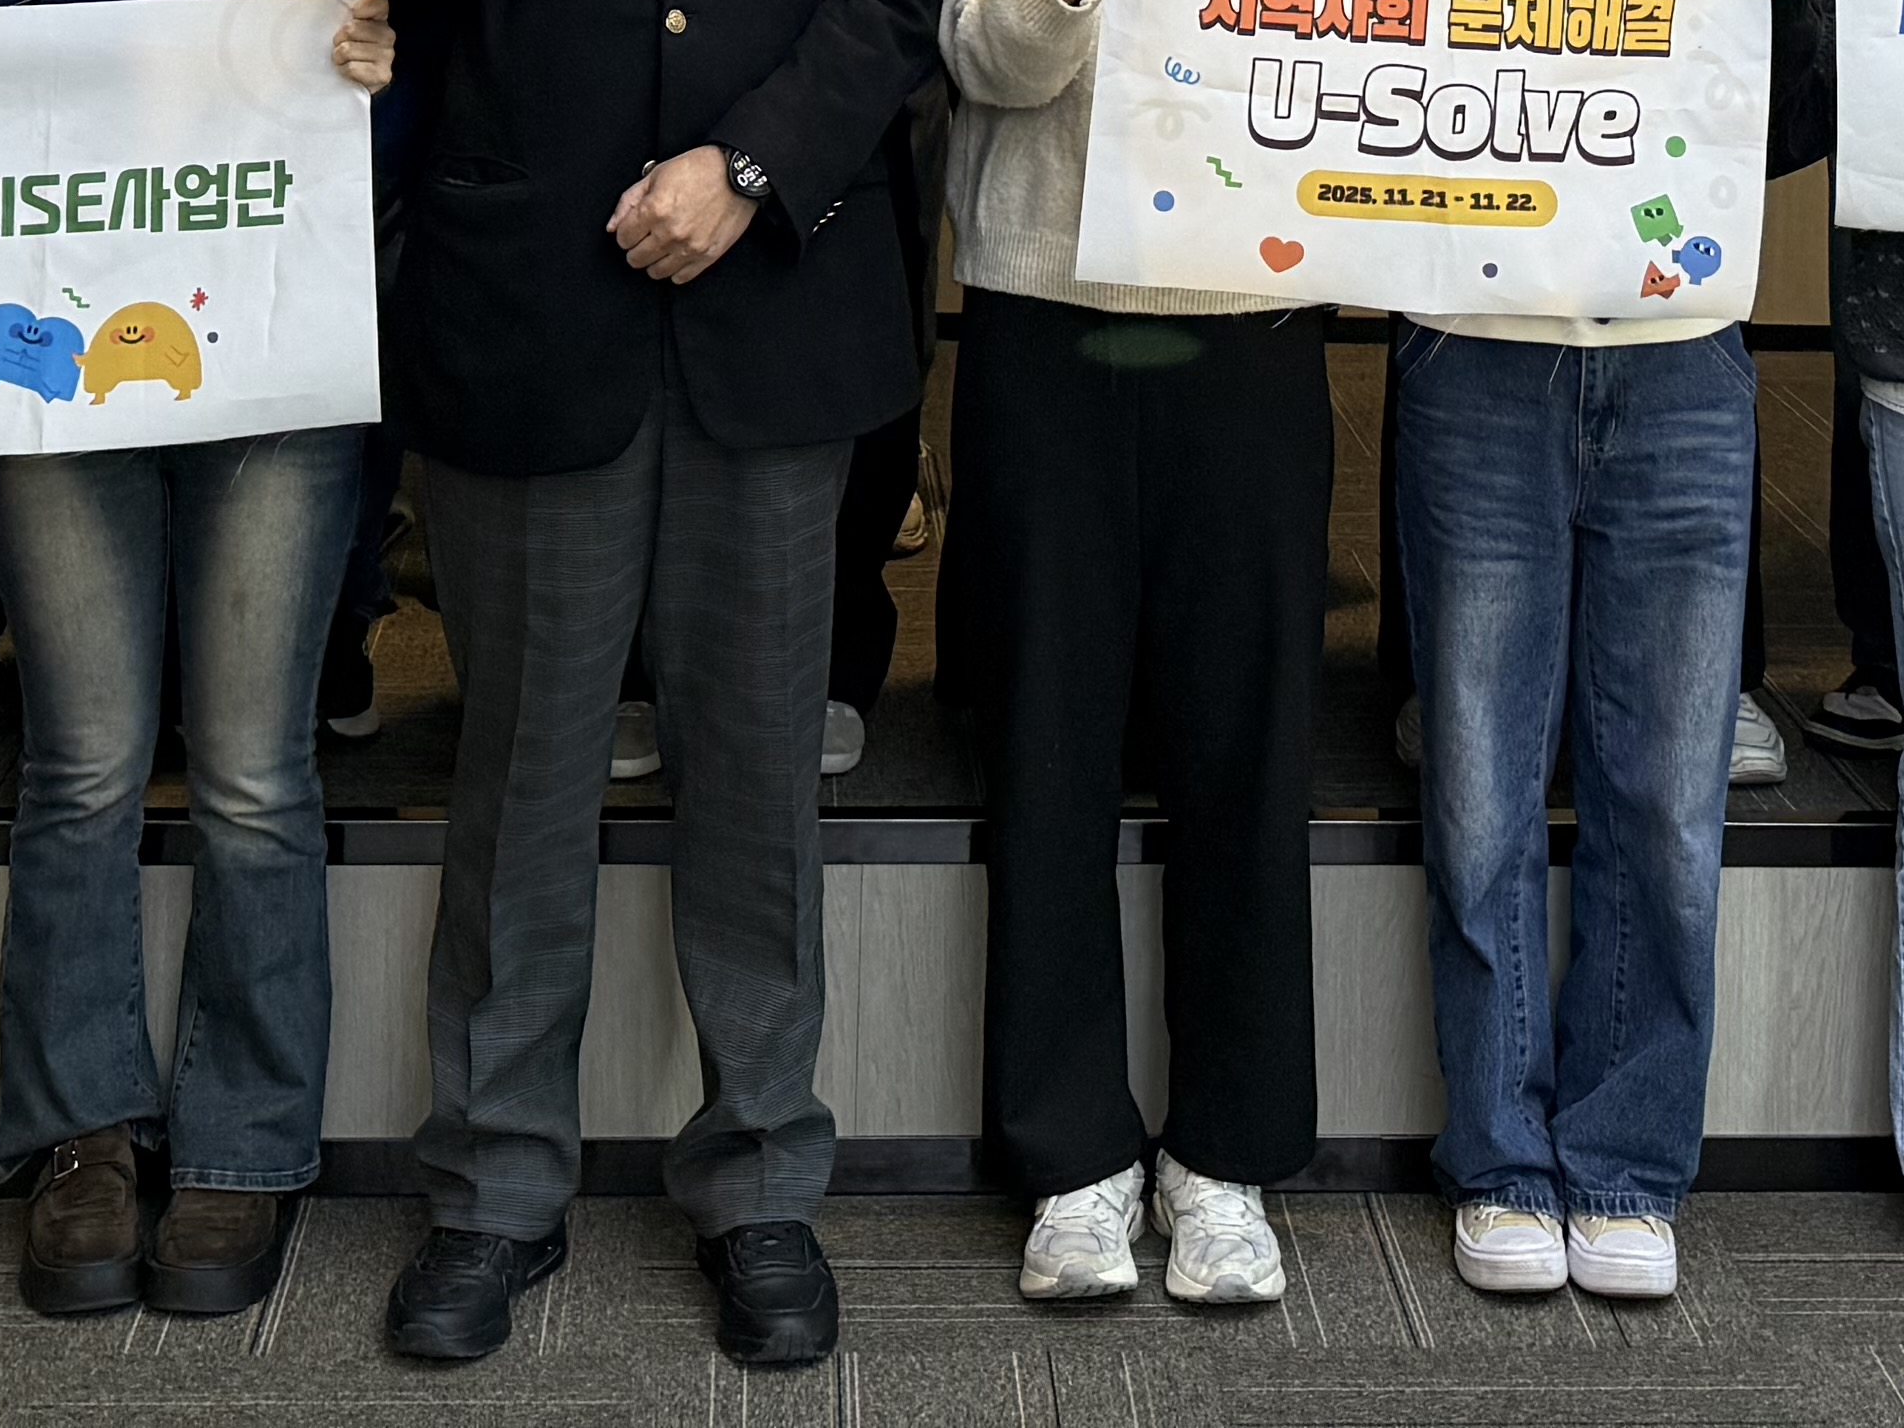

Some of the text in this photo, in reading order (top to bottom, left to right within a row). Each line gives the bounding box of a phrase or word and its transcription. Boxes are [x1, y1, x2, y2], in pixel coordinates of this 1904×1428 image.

[1247, 57, 1641, 167] U-Solve
[1317, 183, 1378, 205] 2025.
[1469, 192, 1501, 211] 11.
[1505, 192, 1537, 212] 22.
